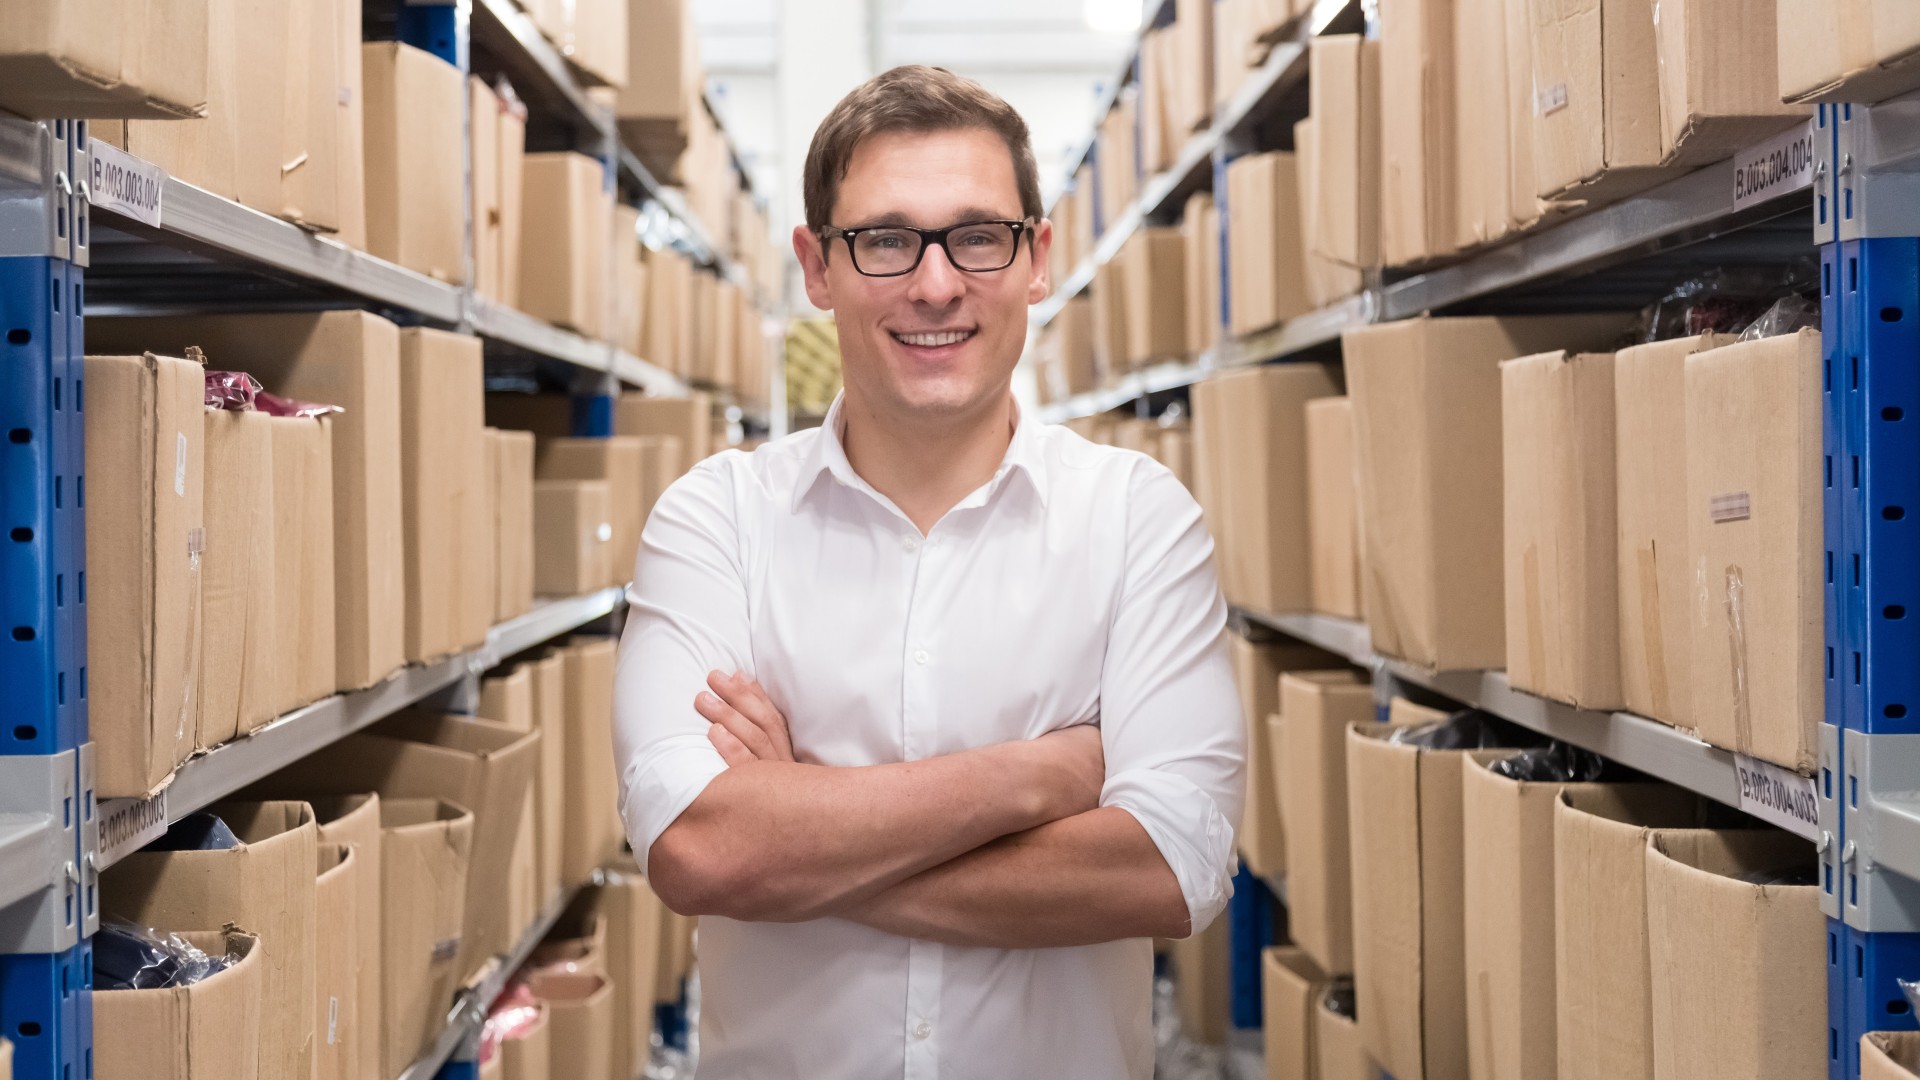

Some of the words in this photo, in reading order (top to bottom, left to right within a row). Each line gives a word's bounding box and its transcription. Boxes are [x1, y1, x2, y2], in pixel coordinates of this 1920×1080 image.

[93, 157, 160, 211] B.003.003.004
[1735, 134, 1813, 201] B.003.004.004
[98, 789, 165, 855] B.003.003.003
[1739, 767, 1818, 826] B.003.004.003
